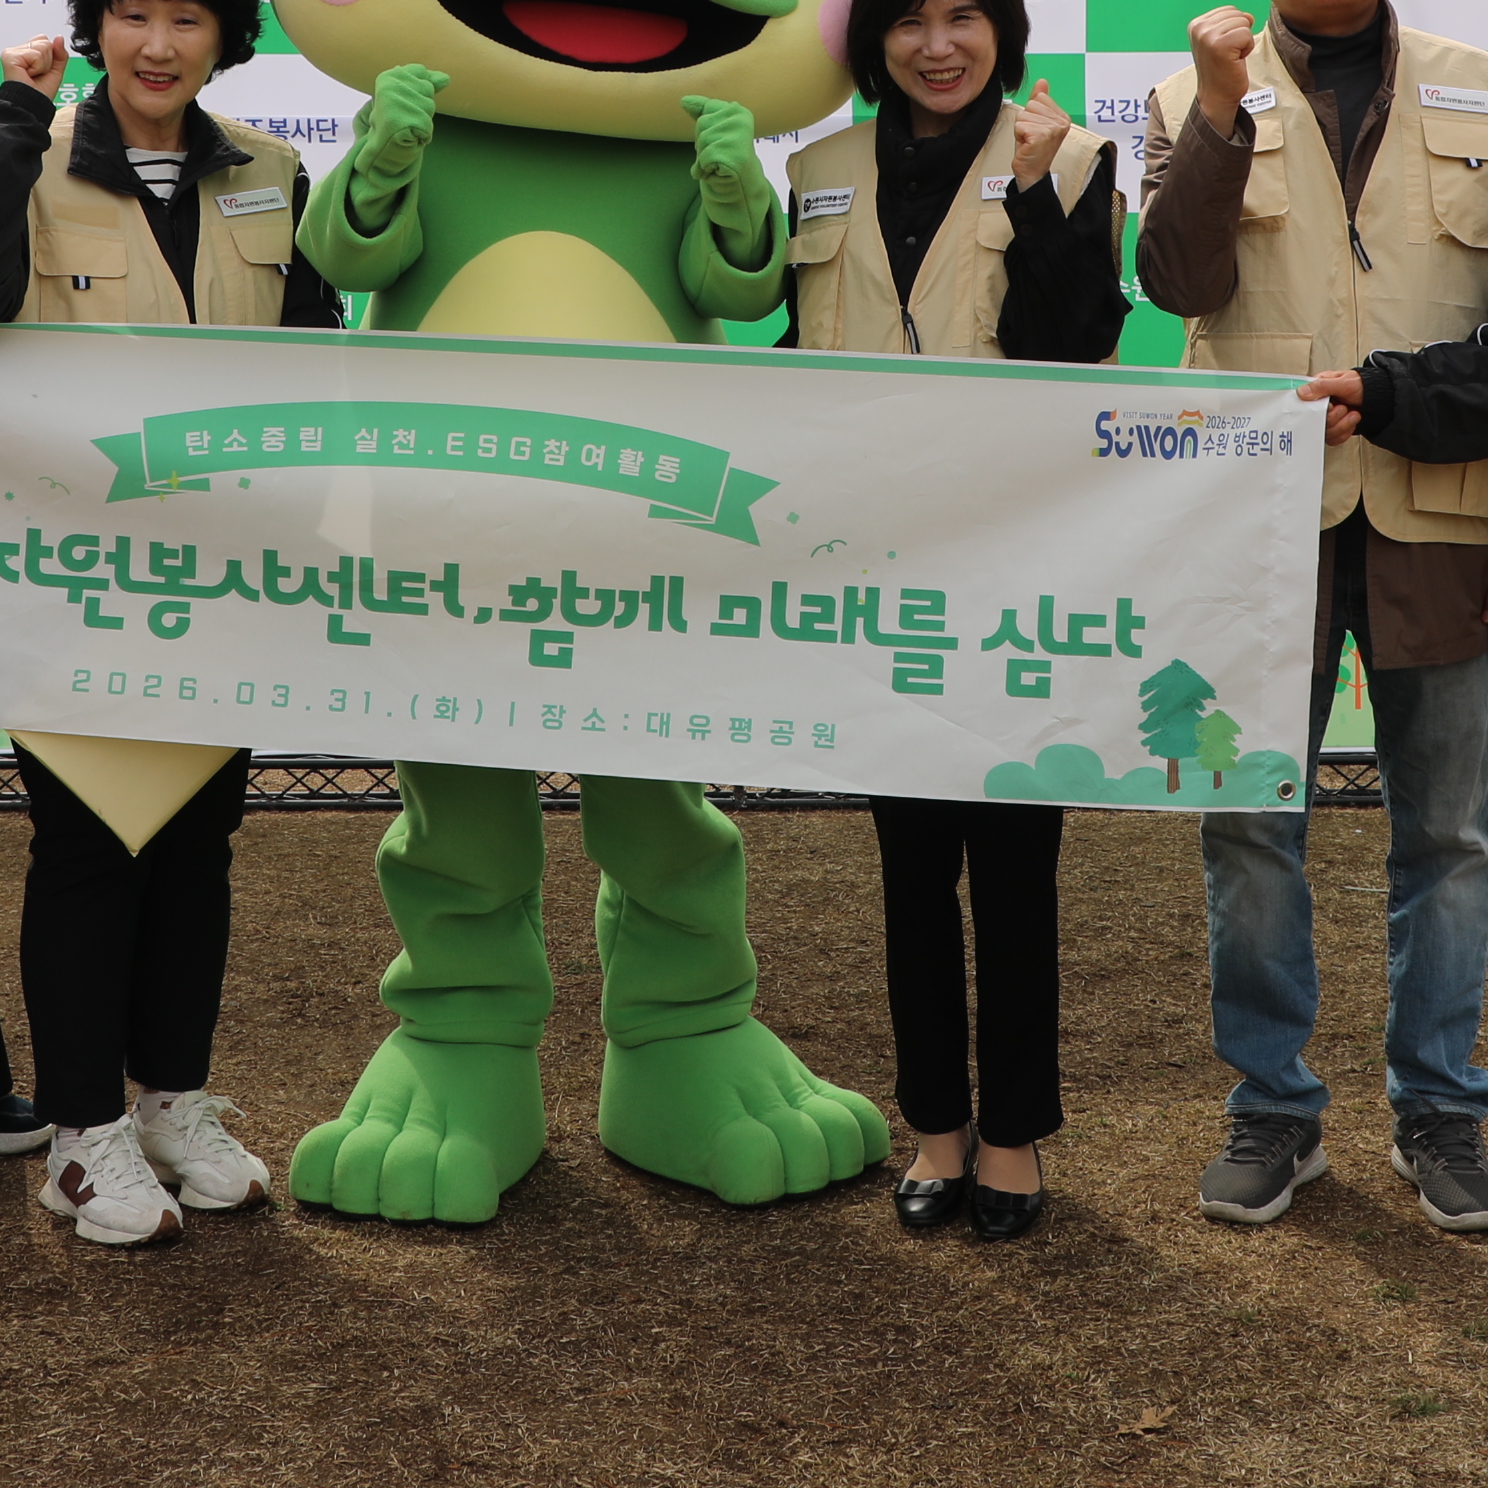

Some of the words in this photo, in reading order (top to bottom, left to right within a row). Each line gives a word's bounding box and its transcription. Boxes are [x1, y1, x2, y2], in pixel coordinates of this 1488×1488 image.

[1122, 411, 1138, 419] VISIT
[1139, 412, 1158, 420] SUWON
[1205, 415, 1252, 430] 2026-2027
[185, 426, 324, 457] 탄소중립
[1202, 432, 1230, 457] 수원
[1233, 430, 1273, 457] 방문의
[1279, 431, 1293, 457] 해
[710, 580, 959, 696] 미래를
[980, 594, 1146, 700] 심다
